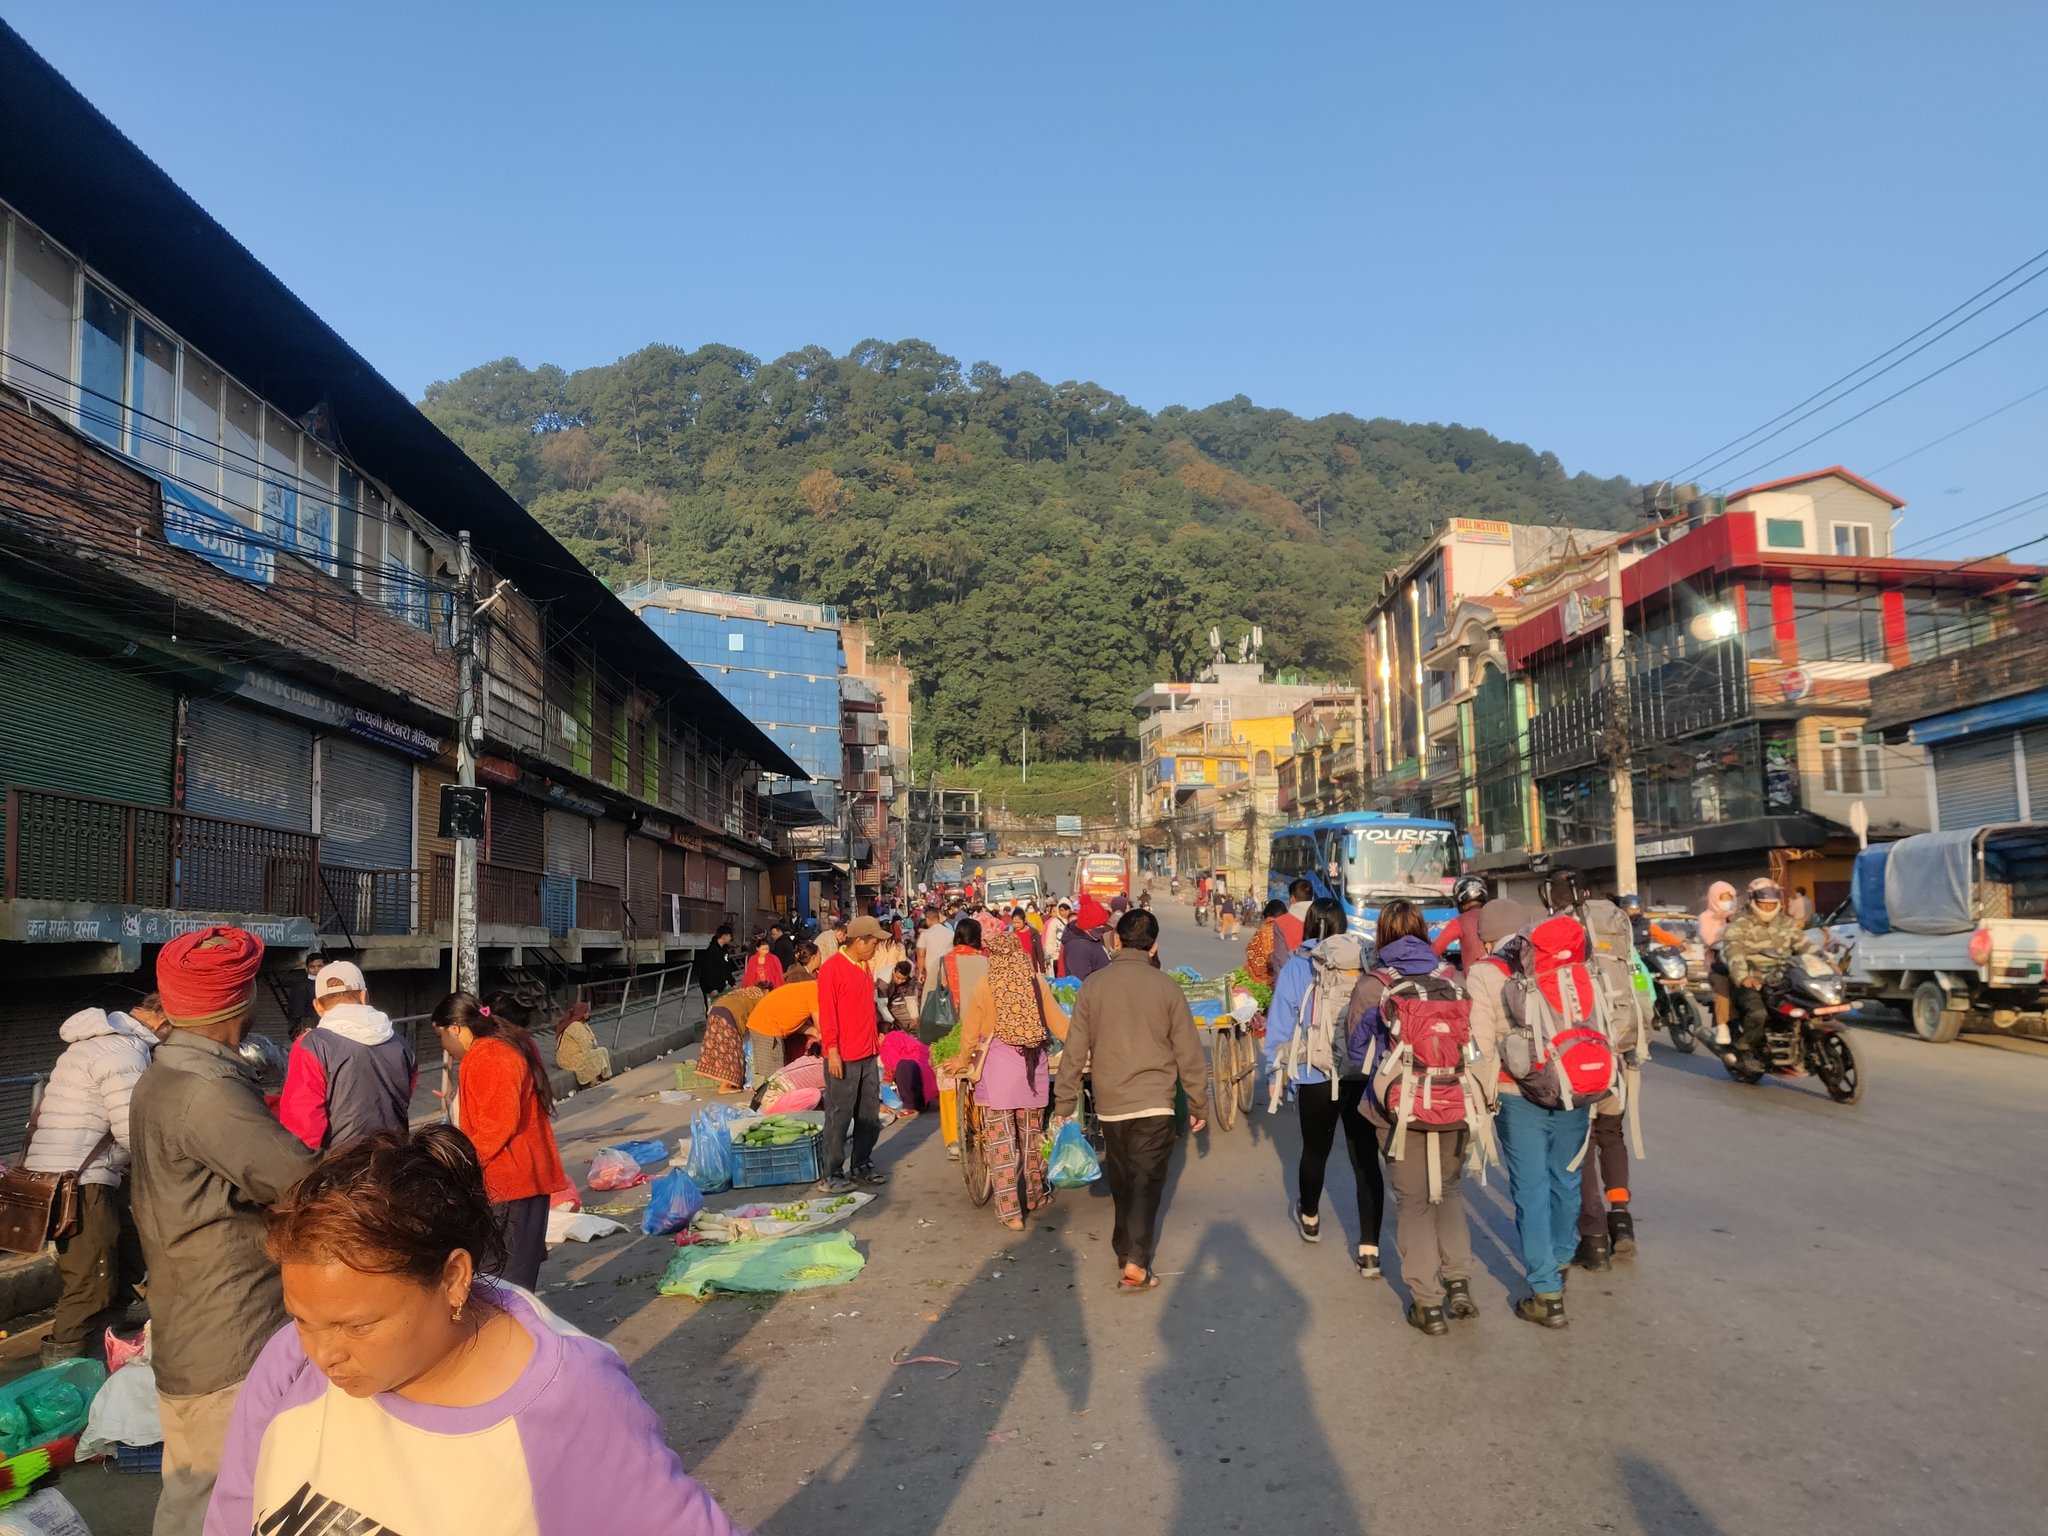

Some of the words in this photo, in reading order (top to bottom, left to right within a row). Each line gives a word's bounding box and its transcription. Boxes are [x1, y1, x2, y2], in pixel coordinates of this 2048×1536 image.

[1456, 519, 1473, 529] DELL
[1474, 520, 1510, 533] INSTITUTE
[1353, 829, 1451, 843] TOURIST
[1394, 844, 1413, 854] AC
[258, 1480, 403, 1536] NIK
